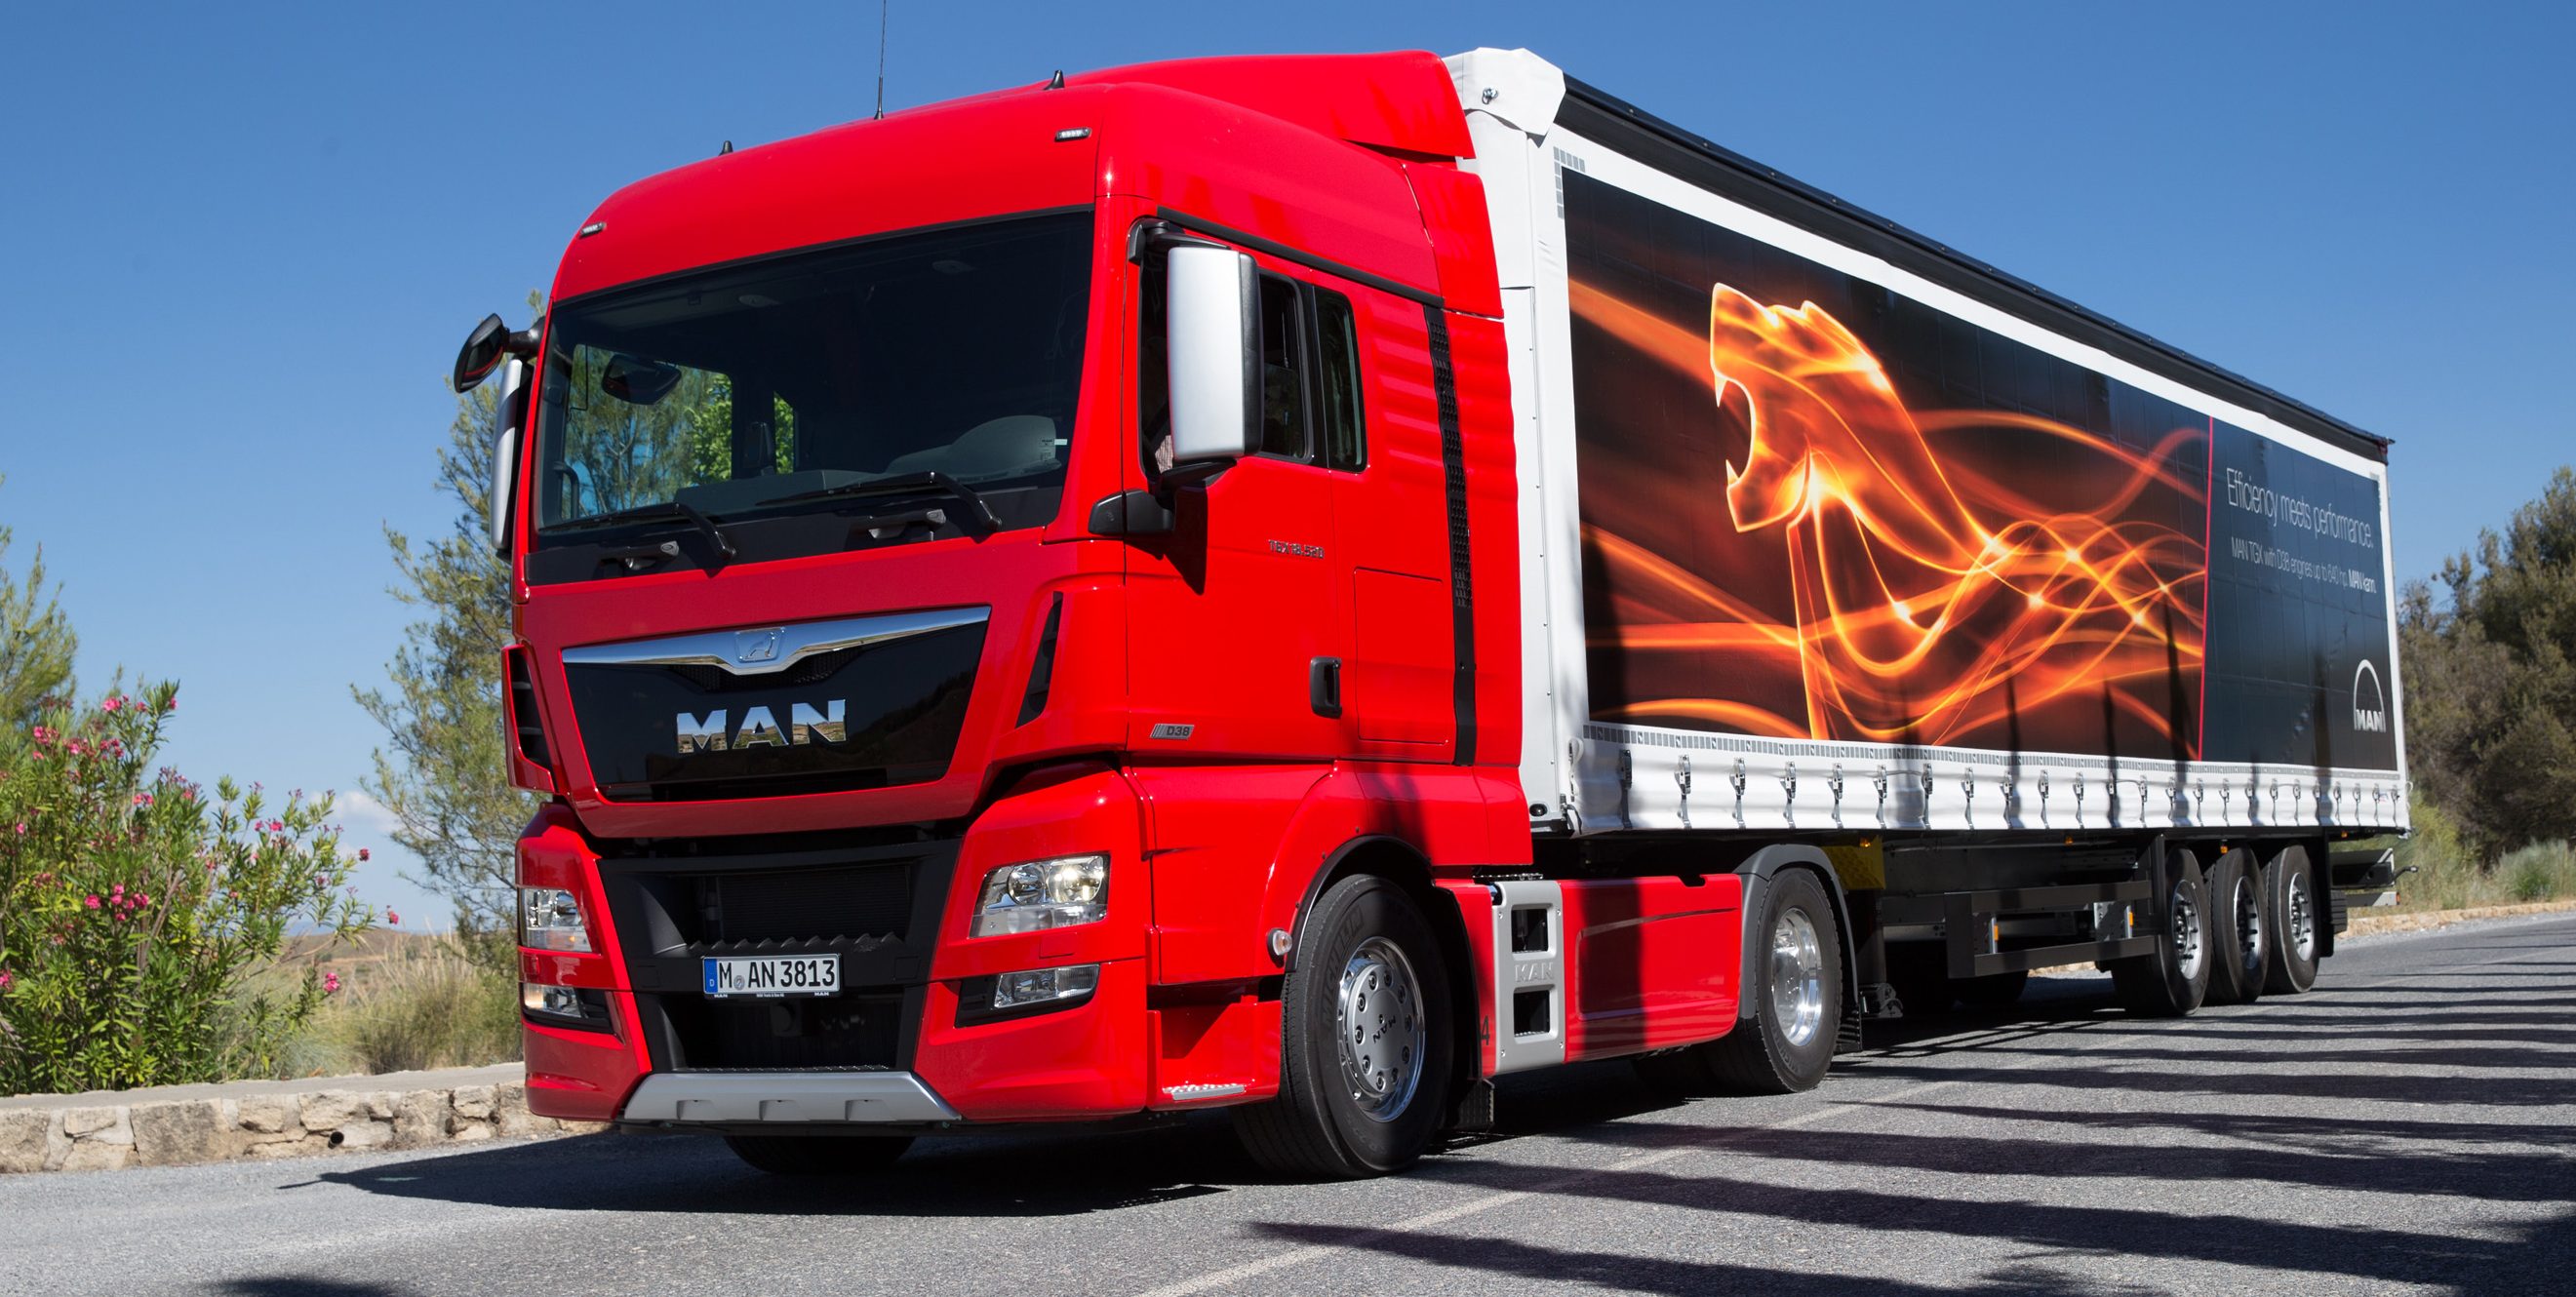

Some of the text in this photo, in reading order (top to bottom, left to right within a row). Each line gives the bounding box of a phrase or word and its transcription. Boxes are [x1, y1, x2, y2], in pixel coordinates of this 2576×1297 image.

[2226, 467, 2374, 549] Efficiency meets performance.
[2231, 536, 2248, 561] MAN
[2248, 540, 2263, 565] TGX
[2264, 547, 2278, 569] with
[2277, 549, 2289, 571] D38
[677, 699, 846, 753] MAN
[1166, 725, 1191, 737] D38
[2356, 709, 2383, 731] MAN
[709, 960, 835, 989] D M AN 3813
[1320, 904, 1364, 1033] MICHELIN
[1514, 962, 1554, 983] MAN
[1372, 1015, 1397, 1044] MAN
